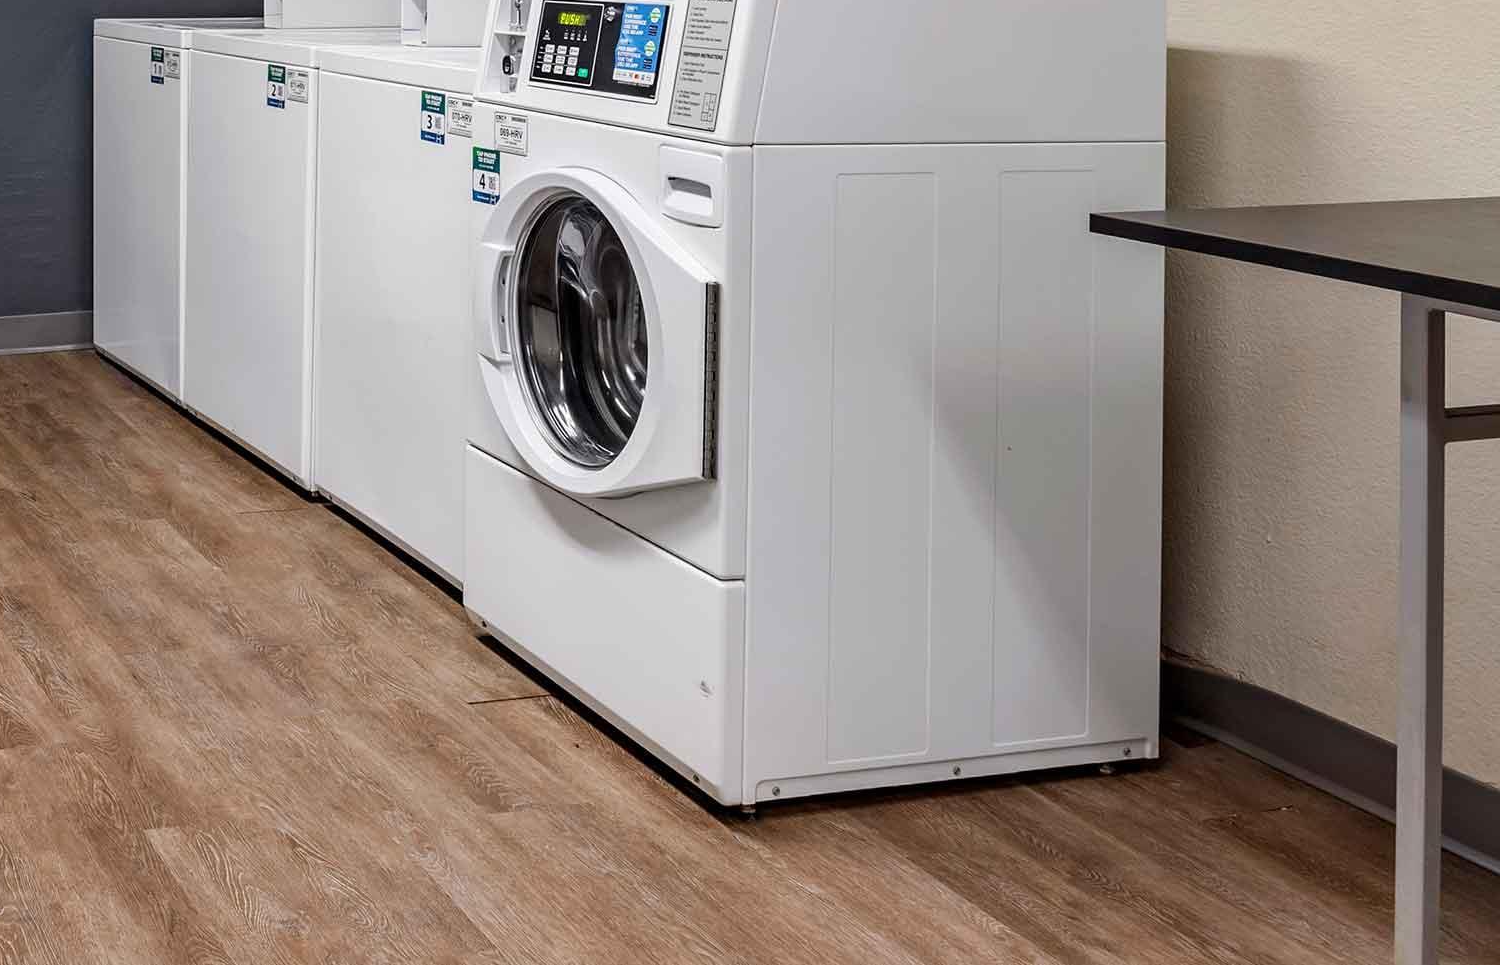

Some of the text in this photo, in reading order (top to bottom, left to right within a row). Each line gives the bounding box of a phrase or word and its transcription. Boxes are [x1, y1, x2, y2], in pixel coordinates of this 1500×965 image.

[271, 84, 276, 96] 2
[427, 115, 432, 129] 3
[479, 173, 485, 189] 4
